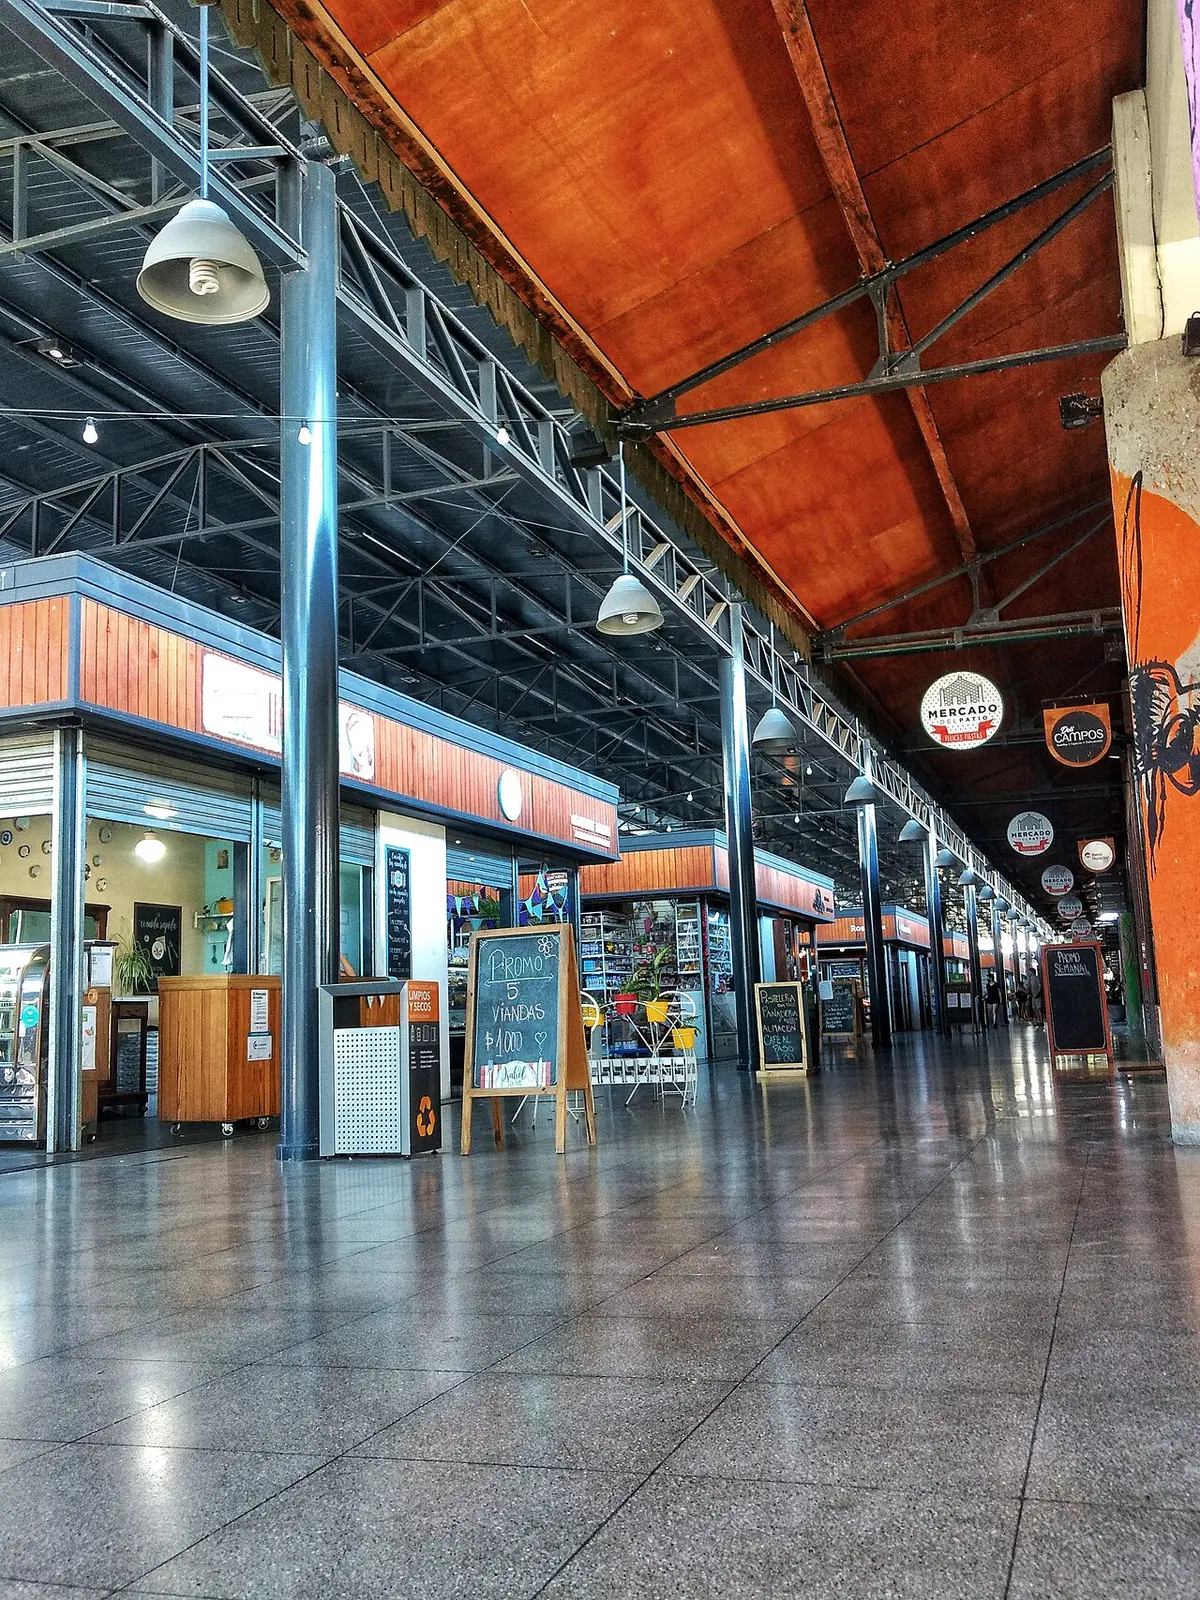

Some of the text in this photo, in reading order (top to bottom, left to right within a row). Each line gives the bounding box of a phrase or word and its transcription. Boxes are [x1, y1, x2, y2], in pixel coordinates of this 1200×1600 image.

[928, 704, 998, 719] MERCADO
[959, 715, 988, 723] PATIO
[1011, 830, 1051, 839] MERCADO
[1057, 951, 1081, 964] PROMO
[488, 949, 543, 980] PROMO
[1054, 962, 1091, 976] SEMANAL
[408, 990, 431, 1001] LIMPIOS
[506, 981, 521, 1000] 5
[409, 1001, 432, 1012] Y SECOS
[763, 1023, 797, 1033] ALMACEN
